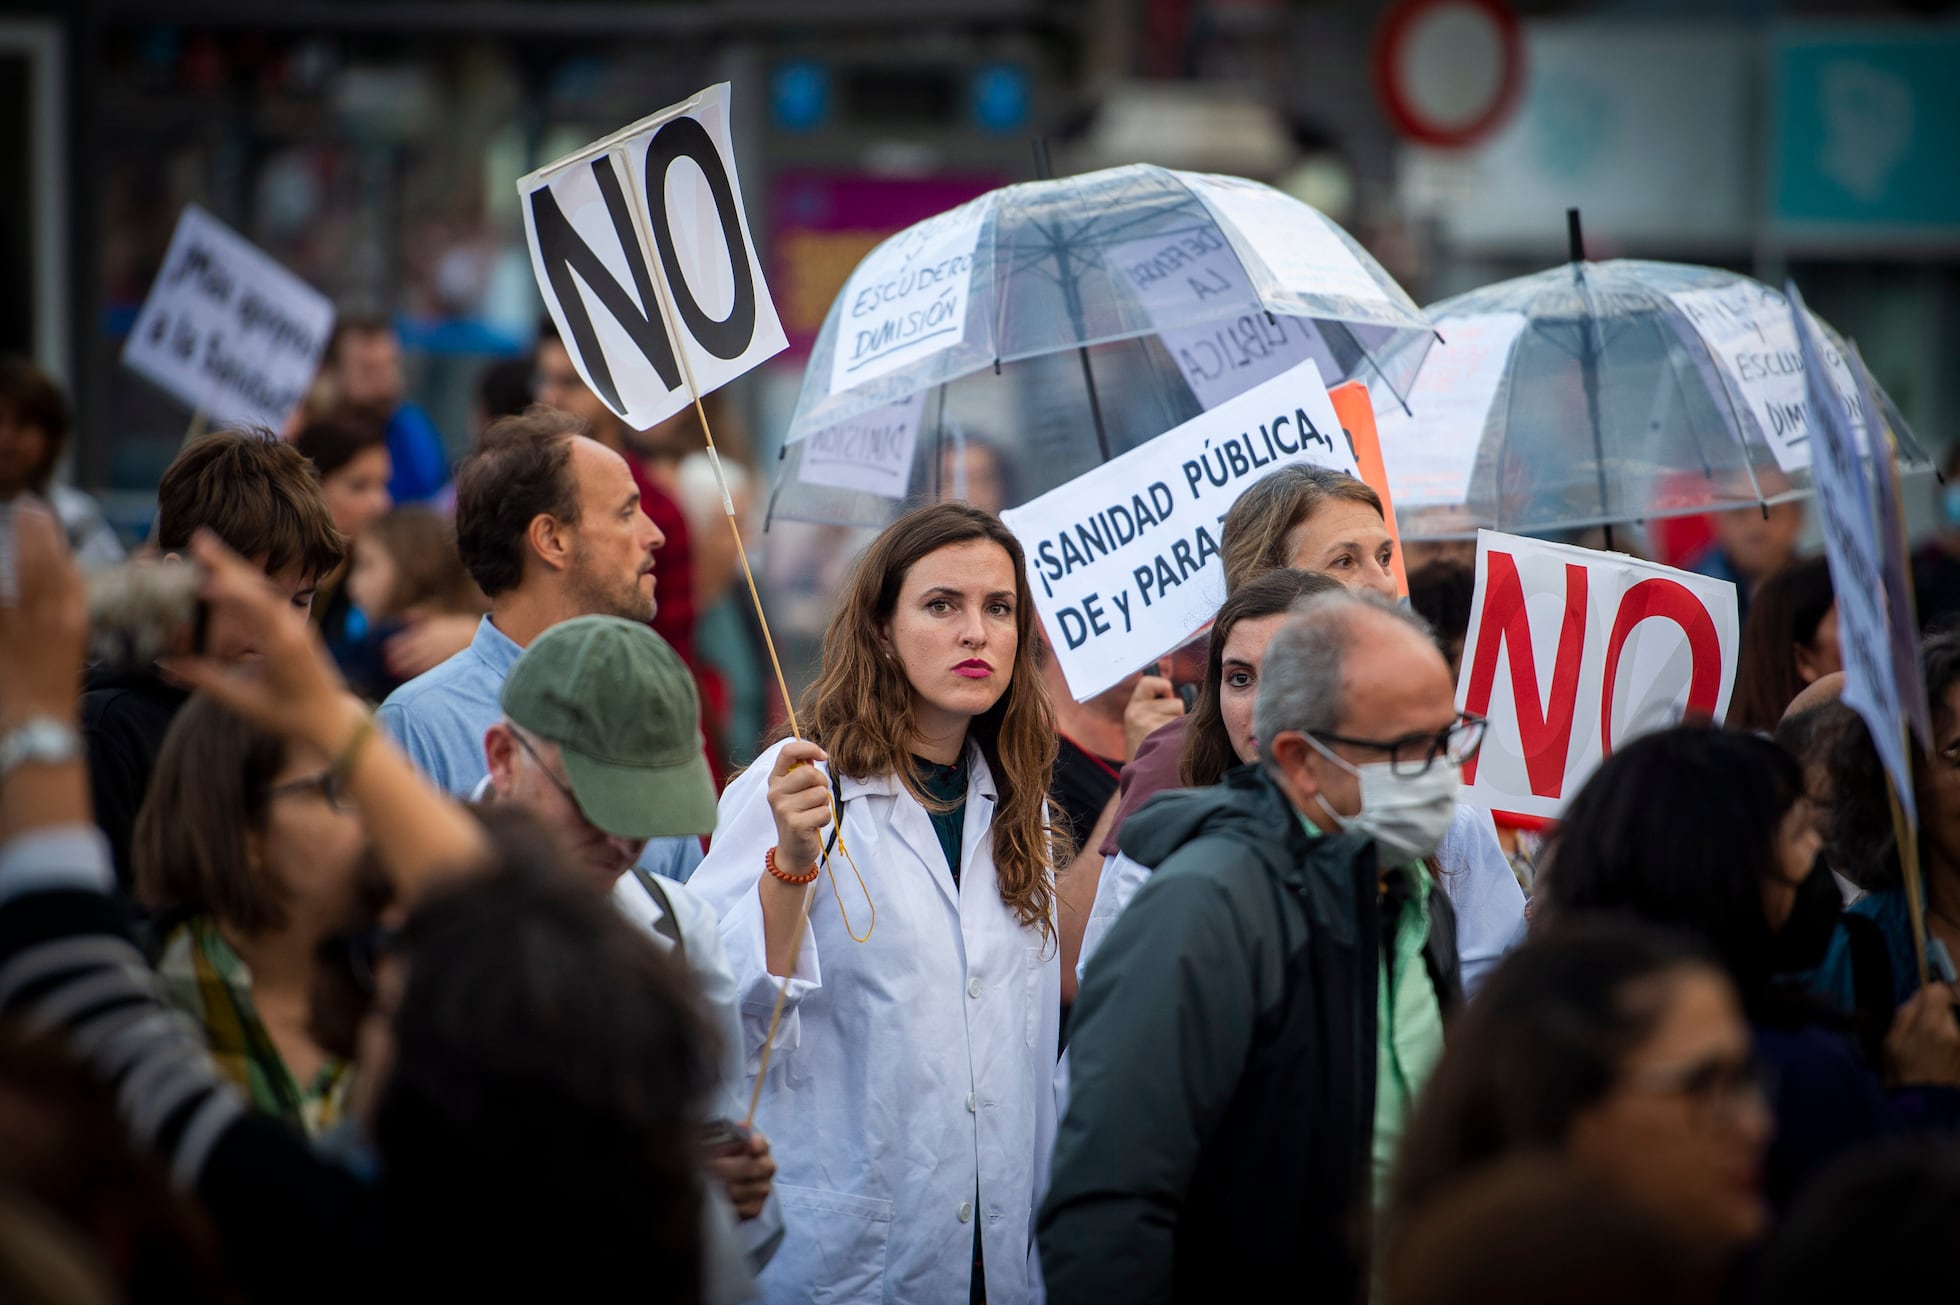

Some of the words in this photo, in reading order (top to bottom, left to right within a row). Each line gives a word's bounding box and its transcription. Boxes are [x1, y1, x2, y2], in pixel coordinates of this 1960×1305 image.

[530, 116, 756, 416] NO
[1034, 481, 1174, 598] ¡SANIDAD
[1182, 408, 1334, 499] PÚBLICA,
[1056, 593, 1111, 650] DE
[1112, 589, 1132, 633] y
[1132, 524, 1223, 607] PARA
[1461, 550, 1722, 799] NO
